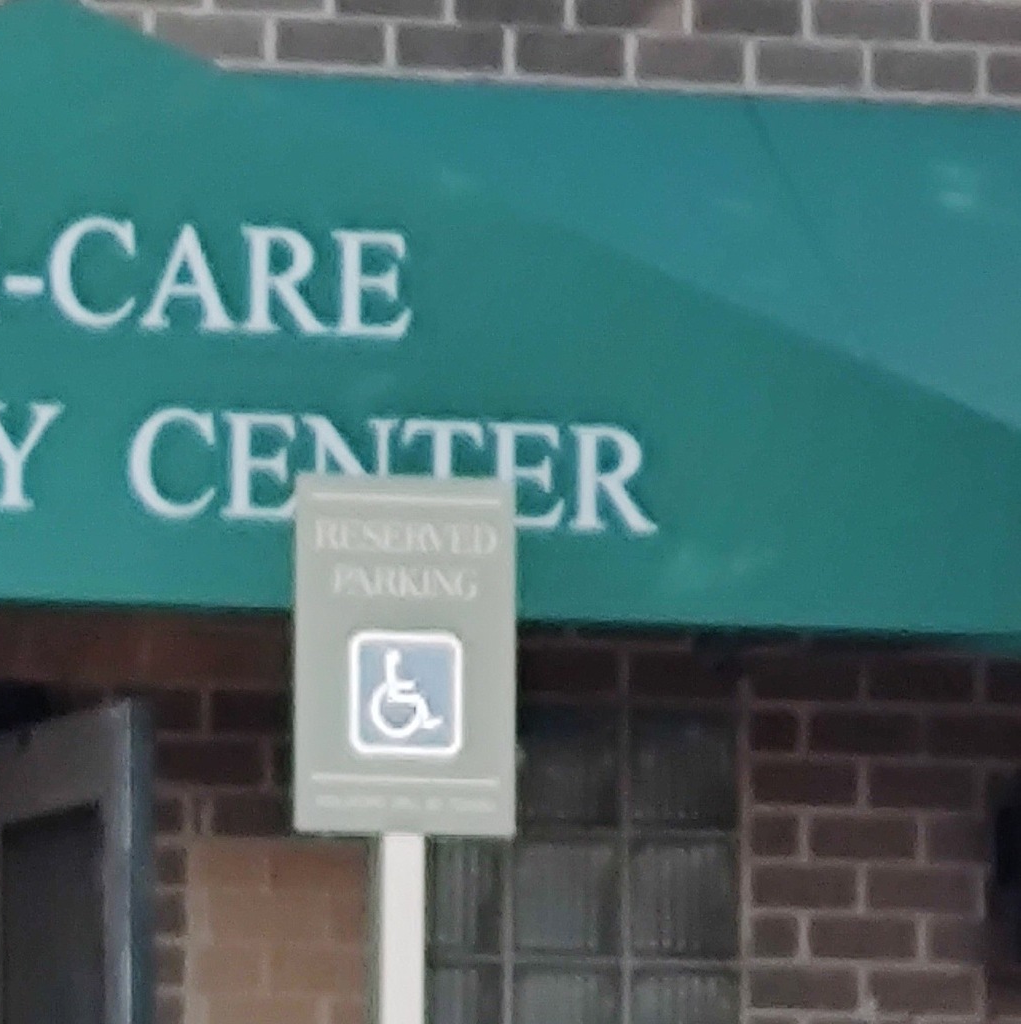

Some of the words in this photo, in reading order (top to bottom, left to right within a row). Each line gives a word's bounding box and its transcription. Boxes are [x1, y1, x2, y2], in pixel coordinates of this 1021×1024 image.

[127, 407, 659, 535] CENTER
[314, 519, 498, 555] RESERVED
[333, 563, 478, 600] PARKING
